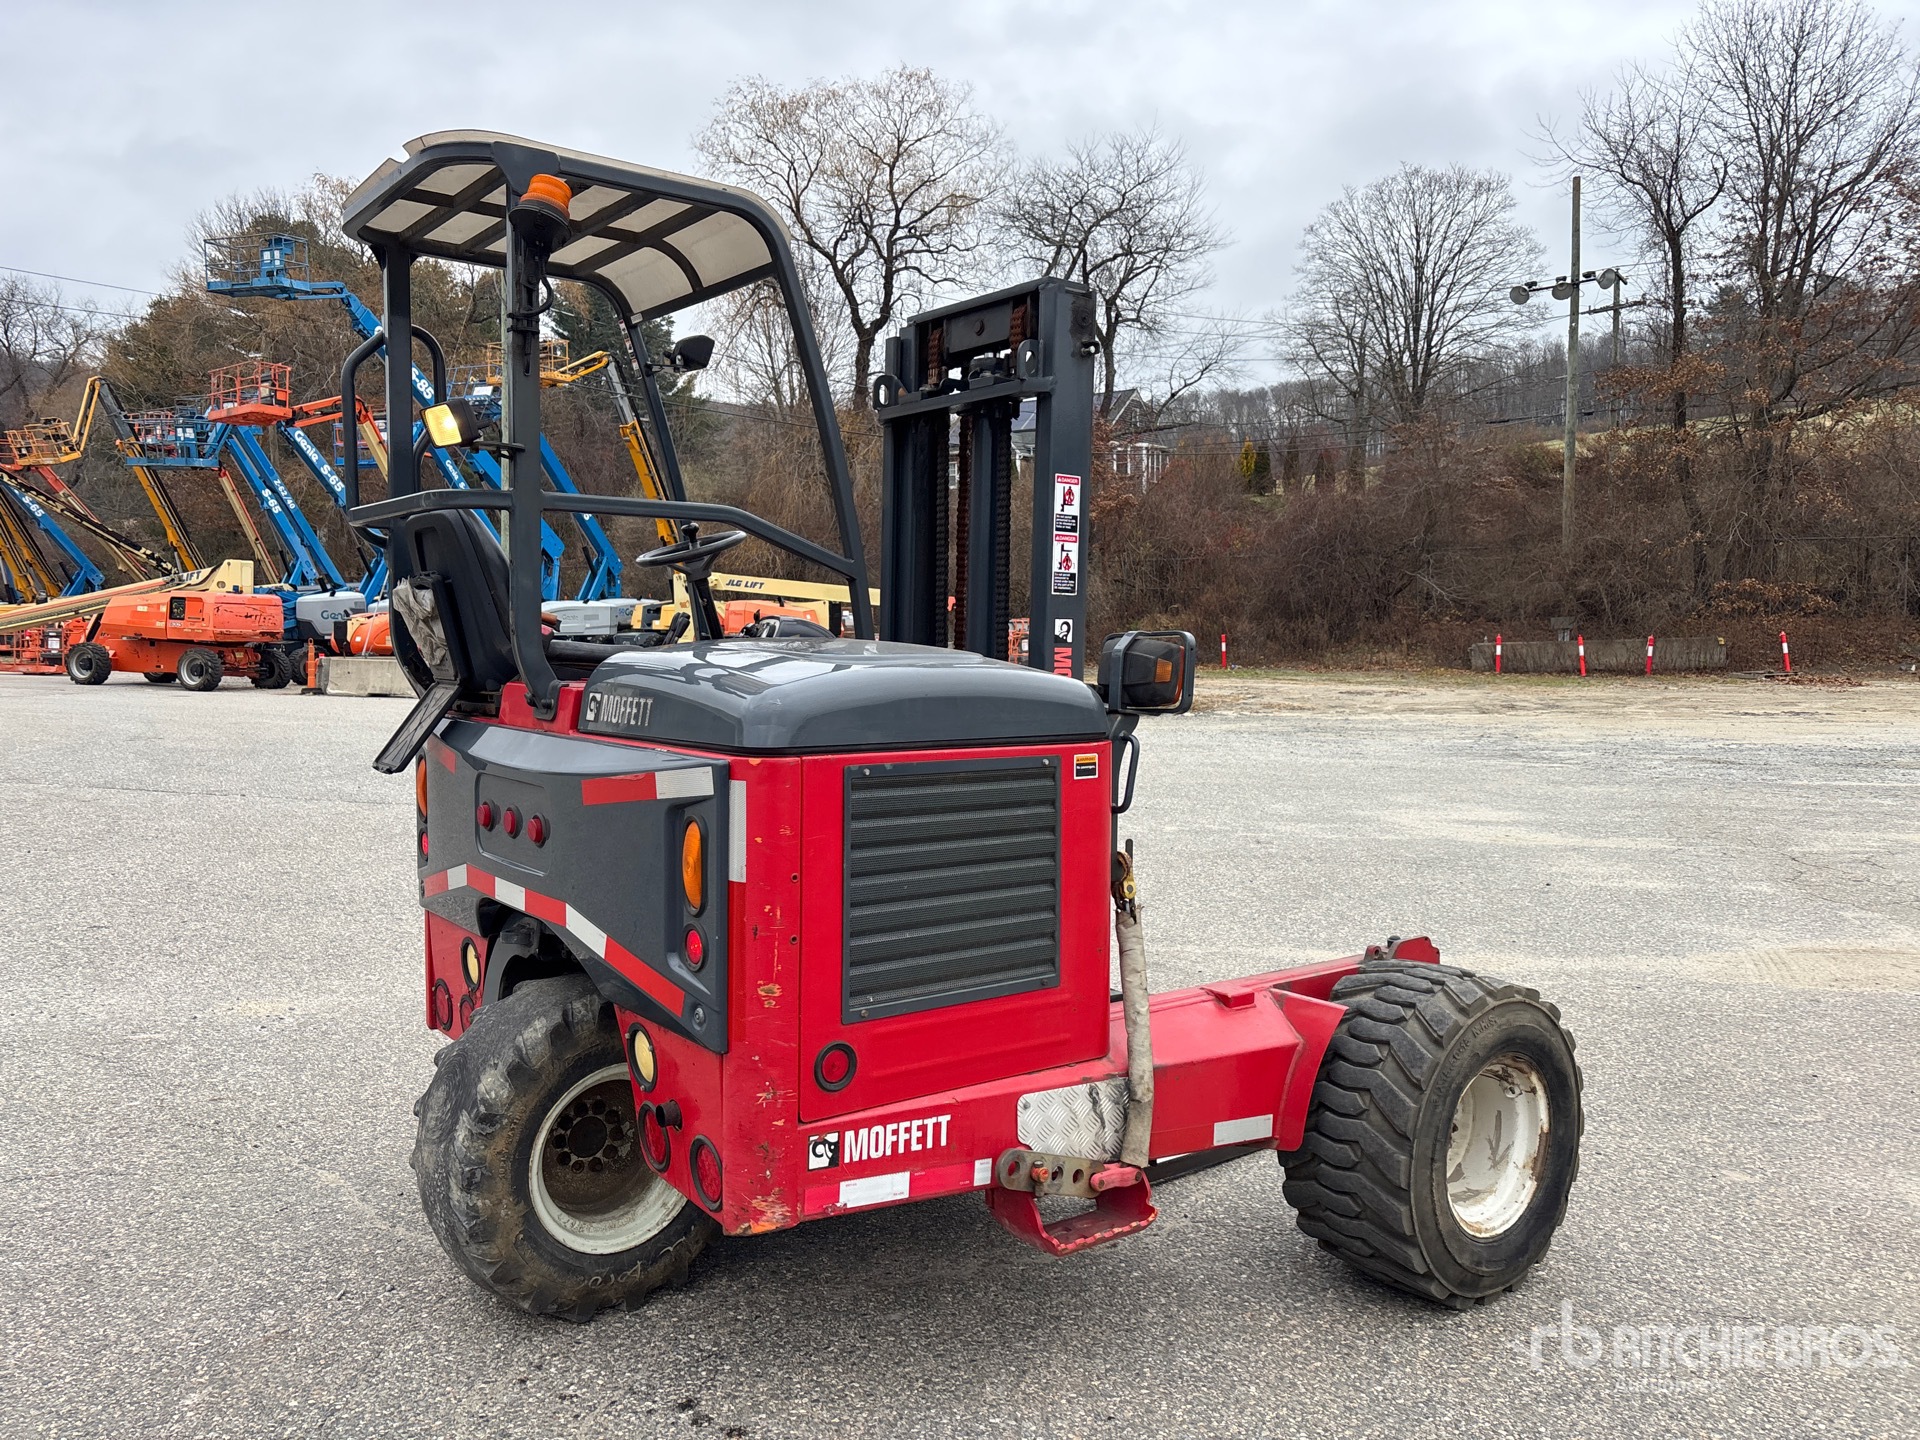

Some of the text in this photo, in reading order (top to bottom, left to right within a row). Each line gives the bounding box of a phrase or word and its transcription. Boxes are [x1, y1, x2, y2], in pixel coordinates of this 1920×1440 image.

[294, 430, 345, 492] Genie S-65
[446, 460, 459, 481] Genie
[22, 495, 46, 517] S-65
[261, 488, 283, 513] S-65
[273, 478, 296, 509] Z-62/40
[725, 578, 765, 590] JLG LIFT
[600, 694, 654, 727] MOFFETT
[843, 1114, 951, 1164] MOFFETT
